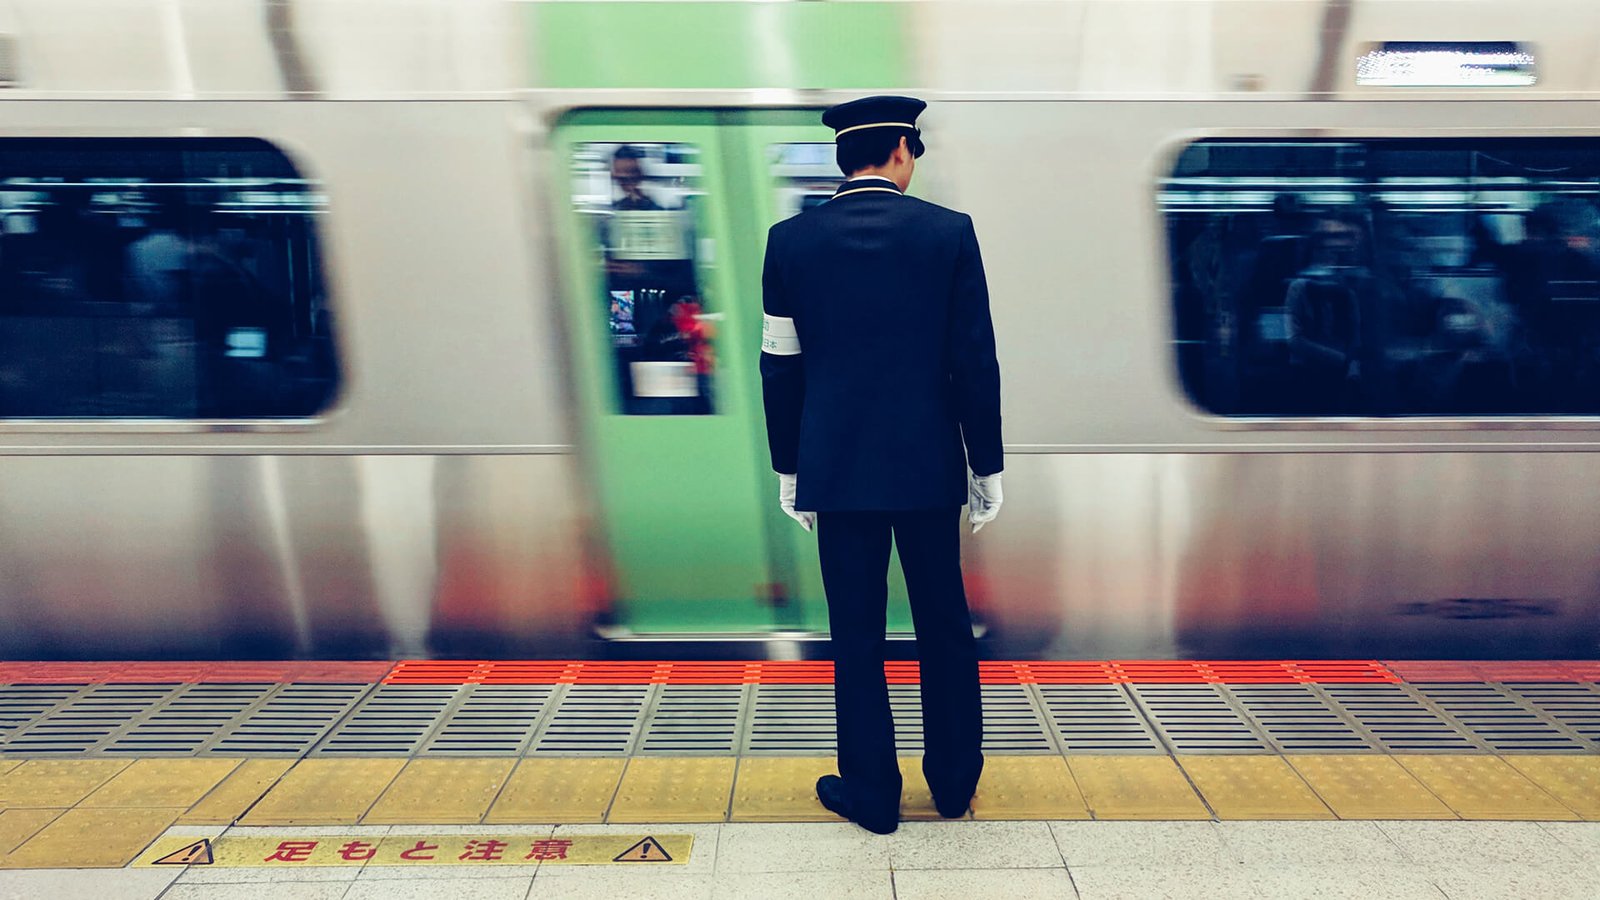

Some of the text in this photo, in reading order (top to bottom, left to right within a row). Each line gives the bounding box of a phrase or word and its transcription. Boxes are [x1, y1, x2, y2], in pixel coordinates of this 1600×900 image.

[264, 840, 574, 862] 足もと注意
